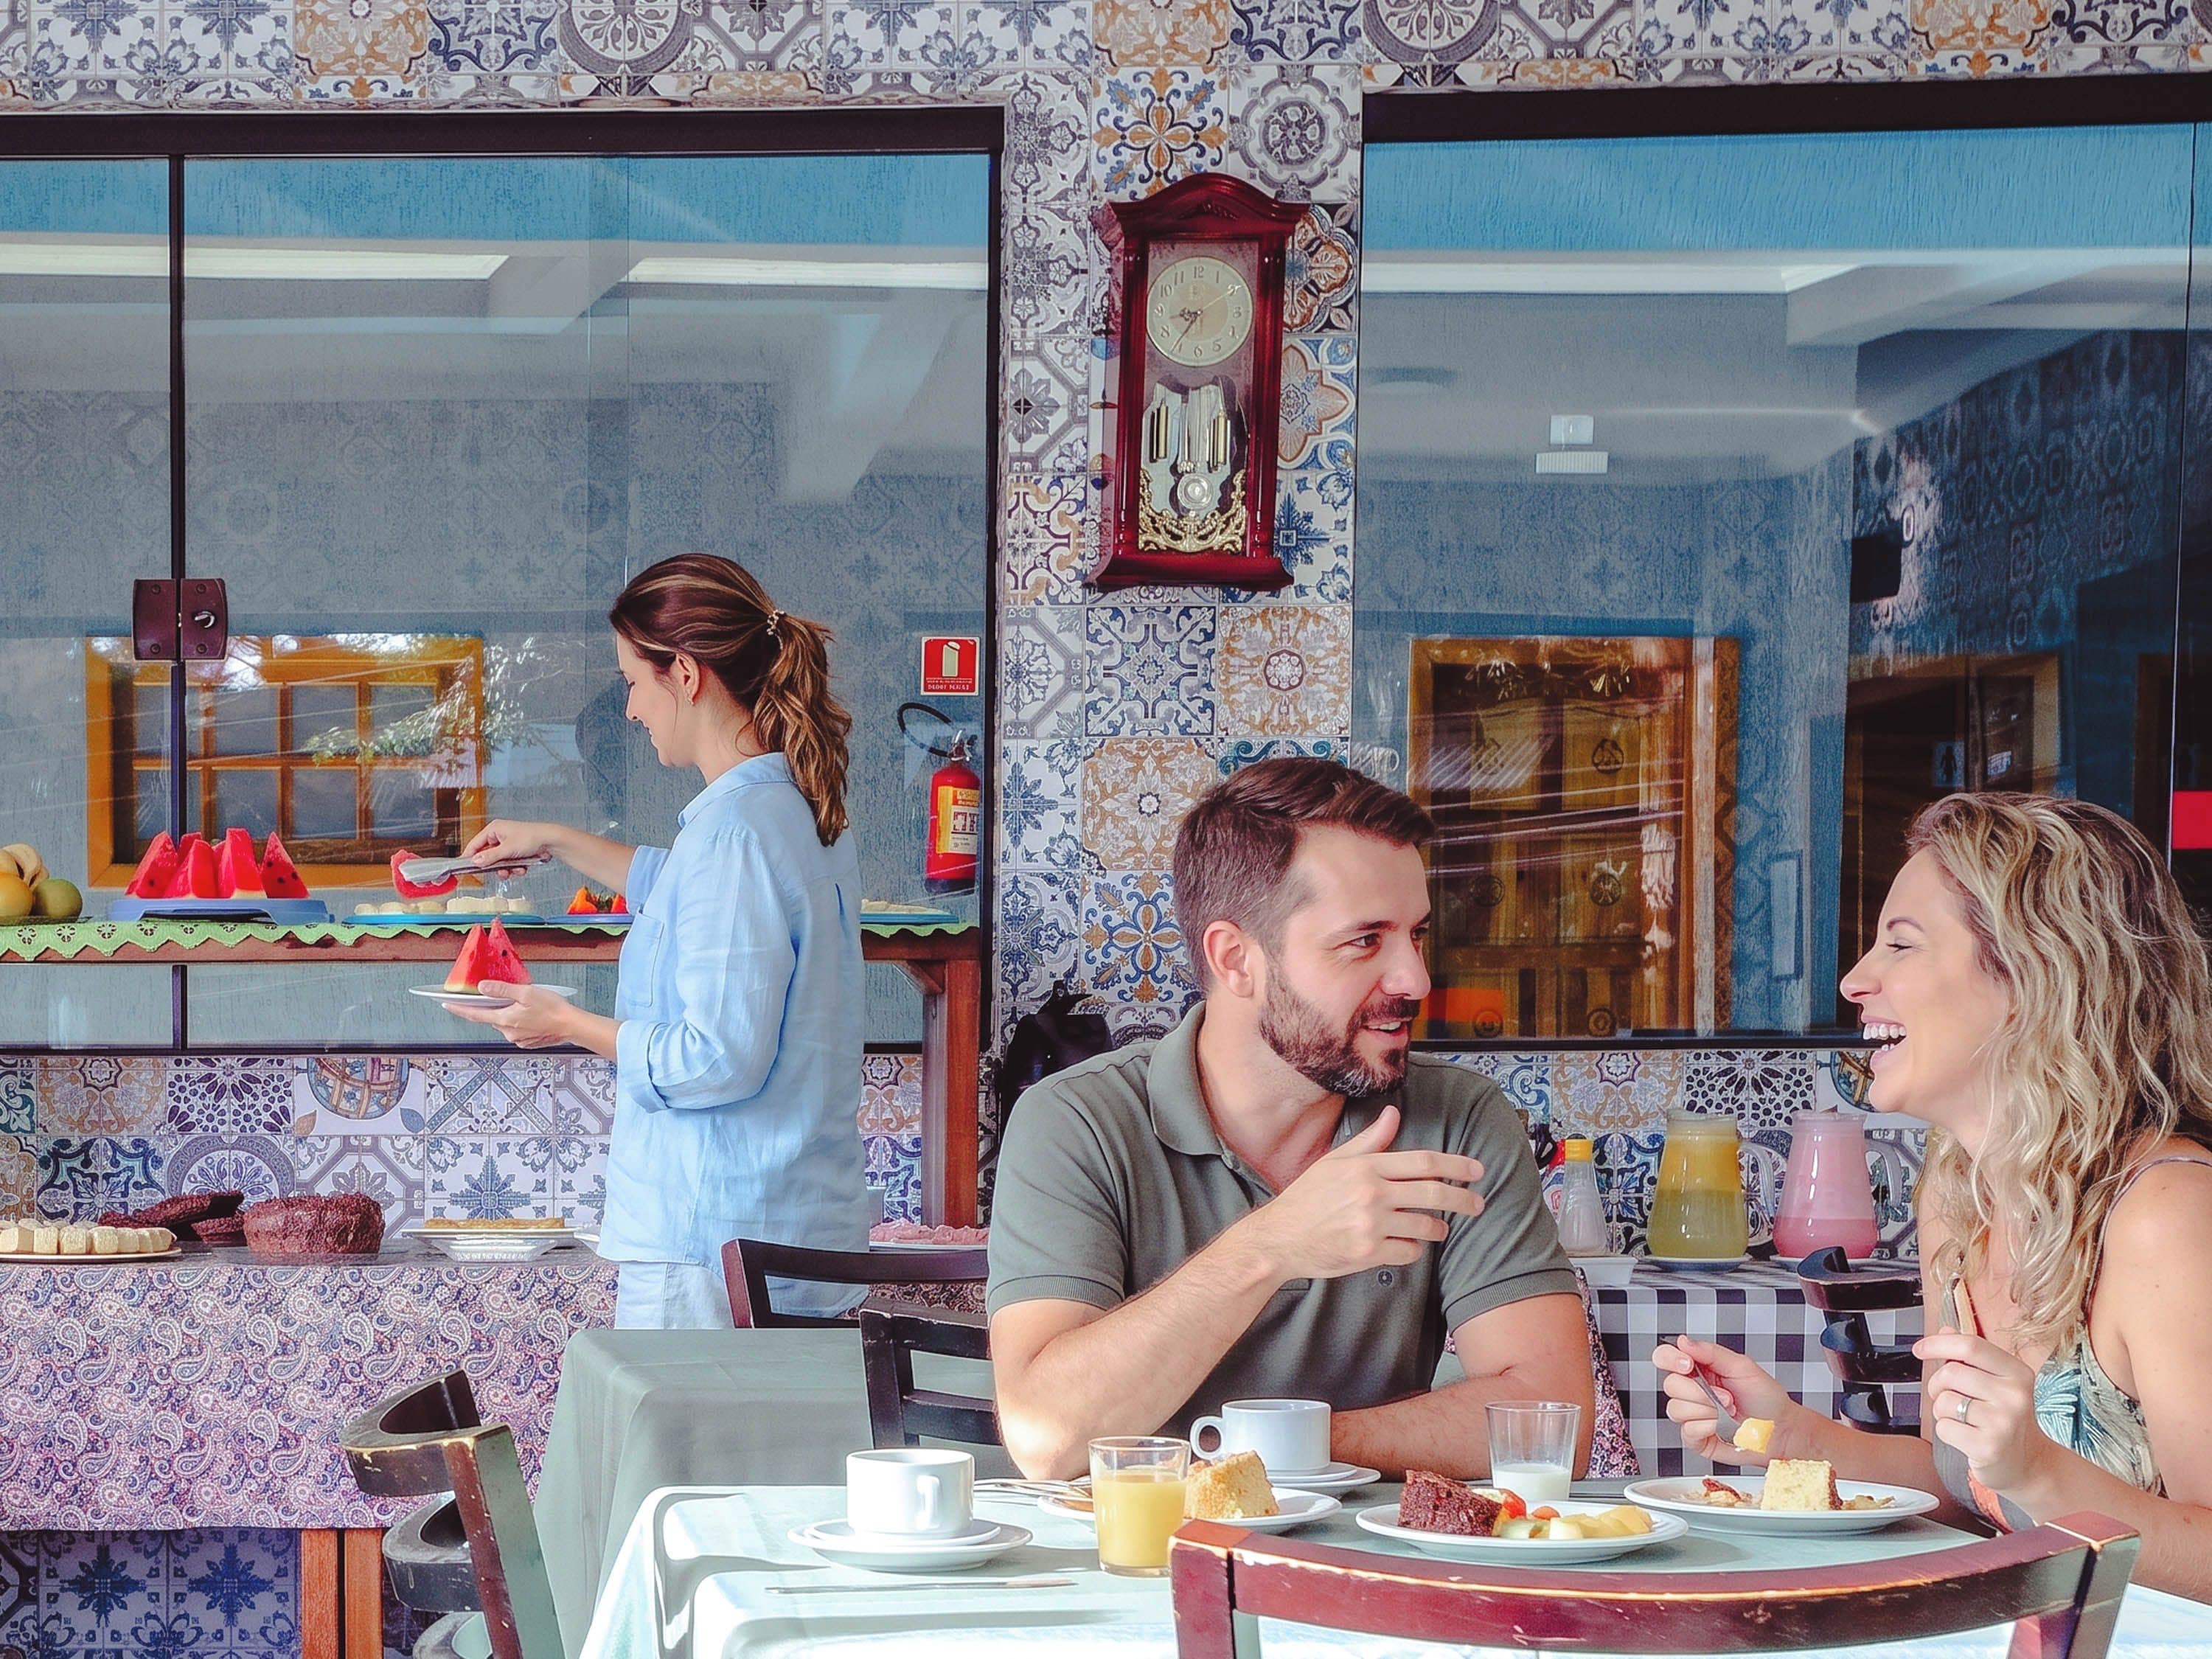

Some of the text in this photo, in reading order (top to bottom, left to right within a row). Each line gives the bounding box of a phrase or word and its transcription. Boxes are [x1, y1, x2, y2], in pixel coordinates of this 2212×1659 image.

[1174, 271, 1184, 285] 11
[1193, 265, 1204, 279] 12
[1160, 284, 1172, 298] 10
[1155, 303, 1164, 317] 9
[1160, 324, 1170, 338] 8
[1194, 345, 1203, 358] 6
[1212, 338, 1222, 352] 5
